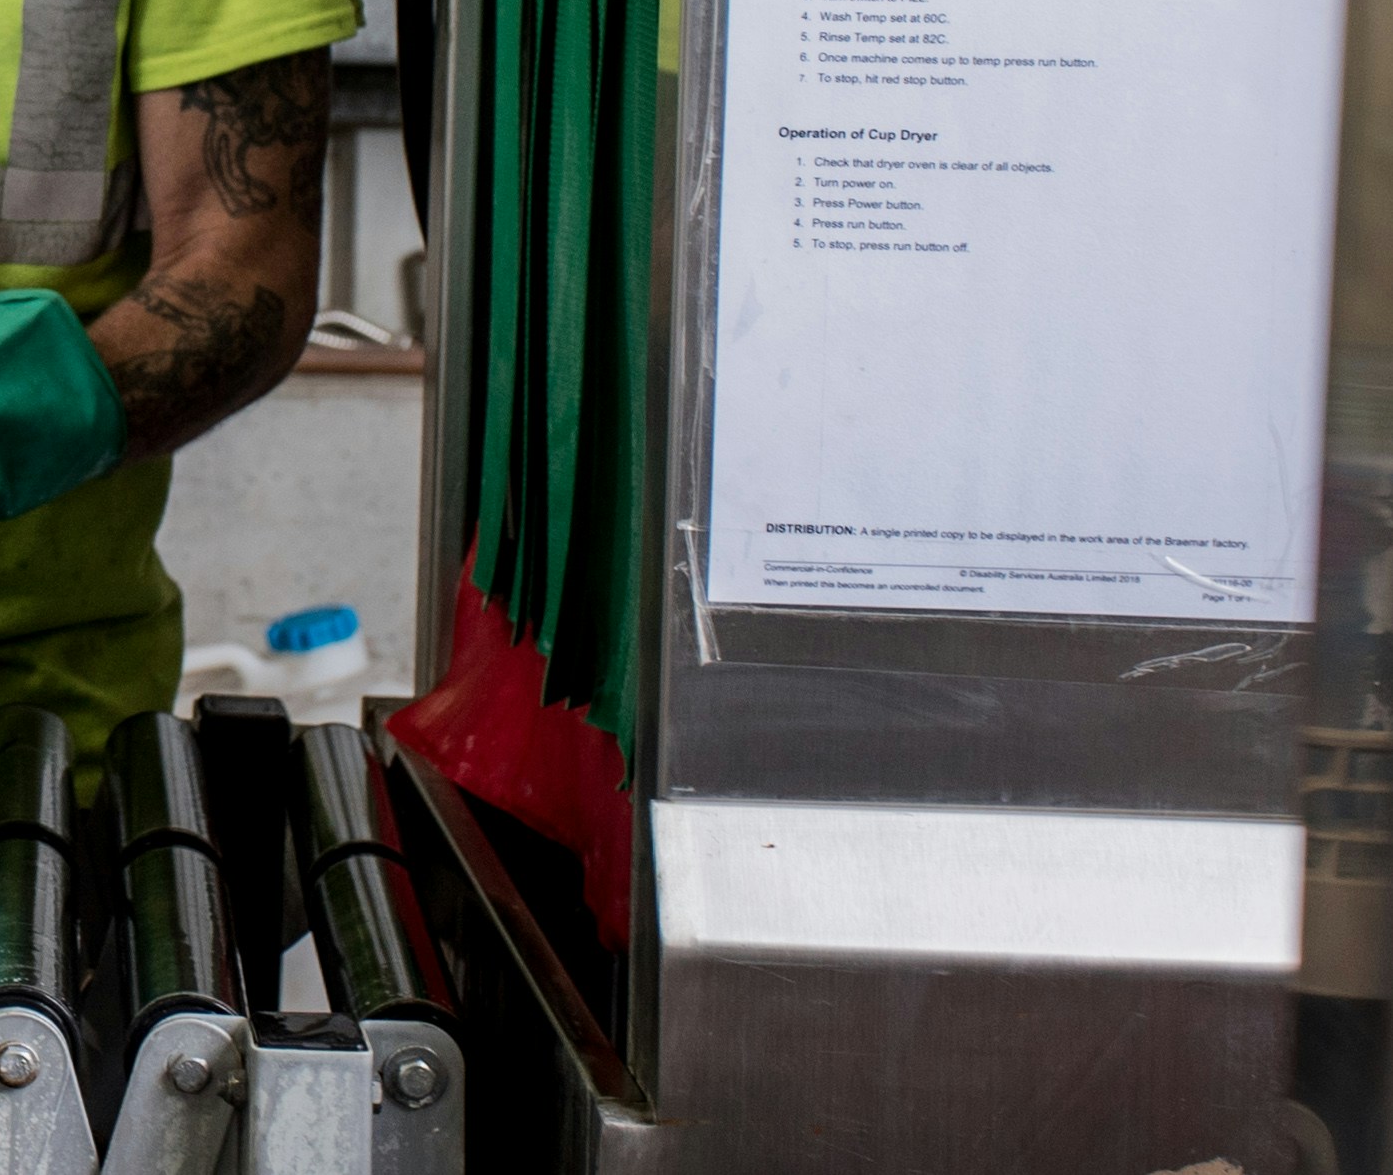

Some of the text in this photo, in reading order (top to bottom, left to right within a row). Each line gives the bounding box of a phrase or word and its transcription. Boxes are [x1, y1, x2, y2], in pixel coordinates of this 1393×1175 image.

[800, 11, 811, 21] 4.
[819, 11, 852, 22] Wash
[855, 11, 887, 24] Temp
[889, 14, 907, 23] set
[909, 14, 921, 24] at
[800, 31, 949, 45] 5. Rinse Temp set at 82C.
[799, 52, 1098, 69] 6. Once machine comes up to temp press run button.
[798, 72, 968, 87] 7. To stop, hit red stop button.
[778, 126, 938, 144] Operation of Cup Dryer
[795, 156, 1055, 175] 1. Check that dryer oven is clear of all objects.
[794, 176, 896, 190] 2. Turn power on.
[794, 197, 924, 210] 3. Press Power button.
[793, 217, 906, 231] 4. Press run button.
[792, 238, 970, 253] 5. To stop, press run button off.
[765, 523, 1249, 551] DISTRIBUTION: A single printed copy to be displayed in the work area of the Braemar factory.
